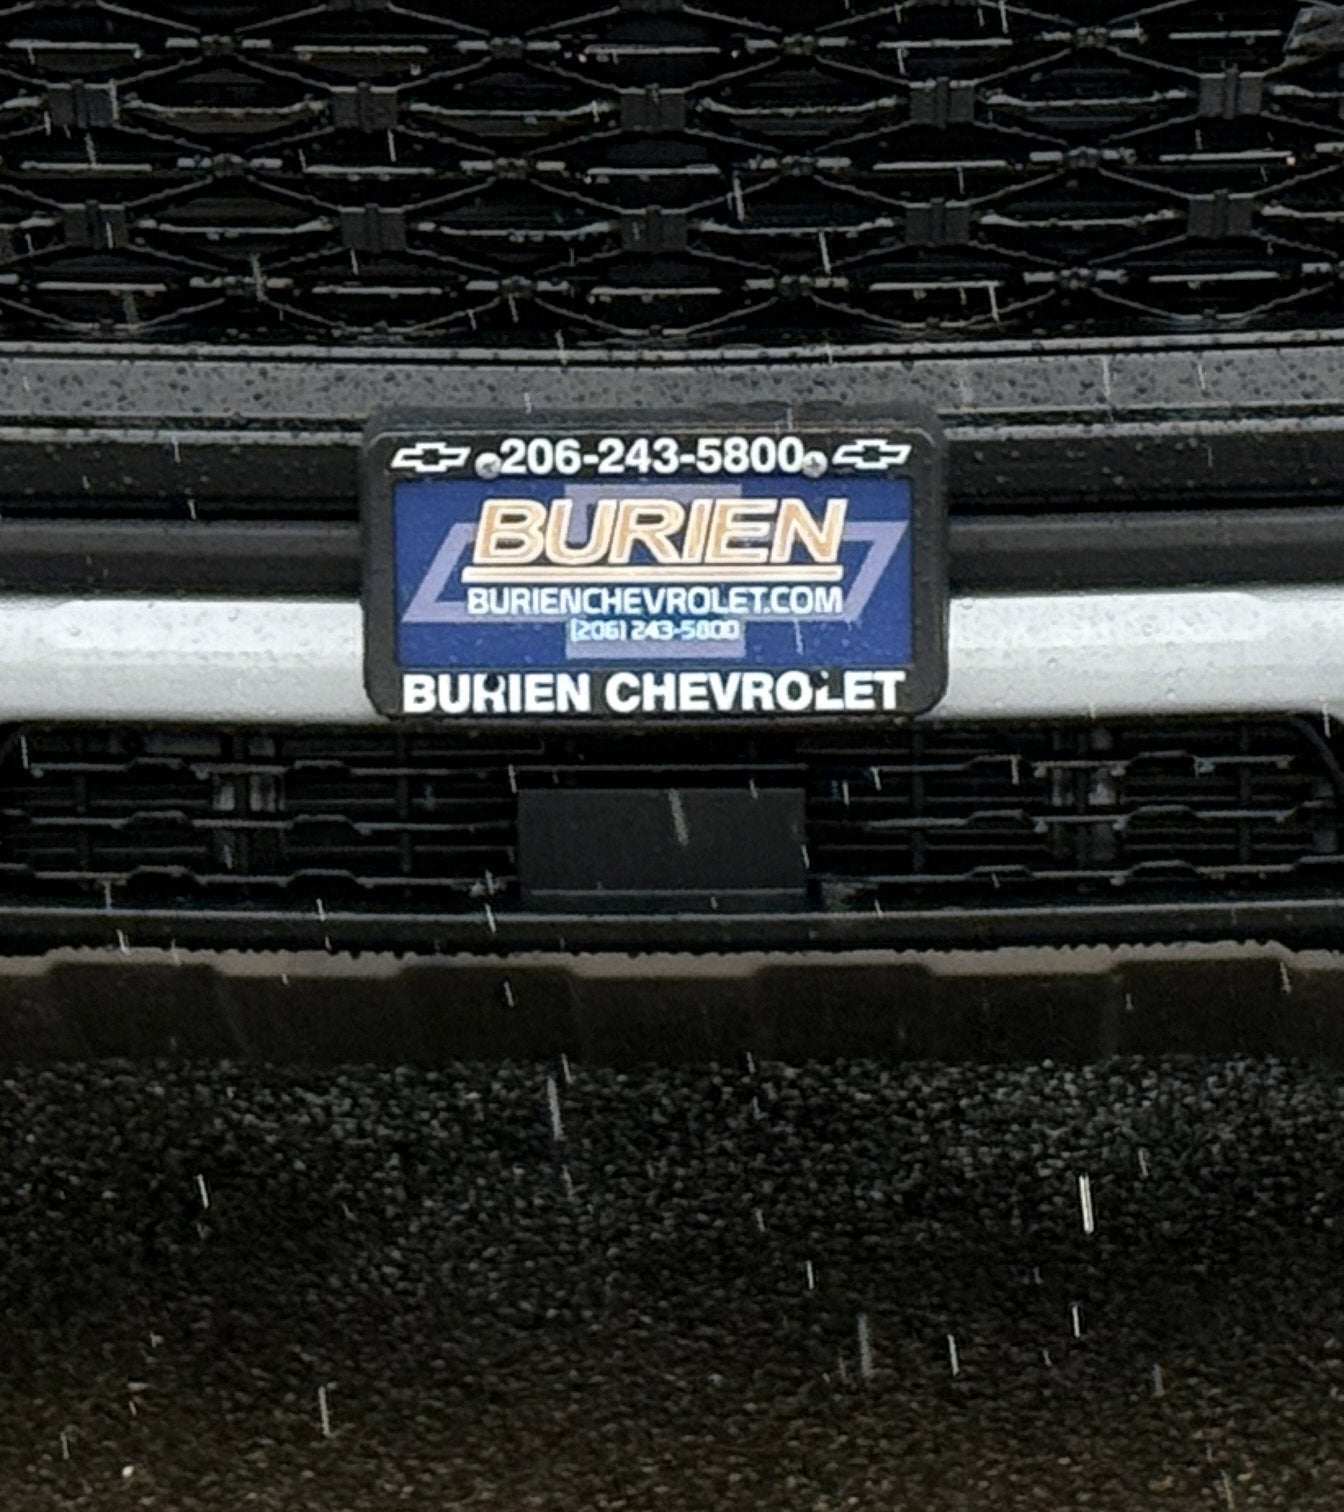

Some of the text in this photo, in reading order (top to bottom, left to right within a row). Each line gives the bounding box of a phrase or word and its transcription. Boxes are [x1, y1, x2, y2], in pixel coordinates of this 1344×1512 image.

[499, 437, 804, 476] 206-243-5800
[471, 497, 849, 565] BURIEN
[466, 586, 843, 616] BURIENCHEVROLET.COM
[631, 619, 741, 642] 243-5800
[402, 670, 906, 714] BURIEN CHEVROLET
